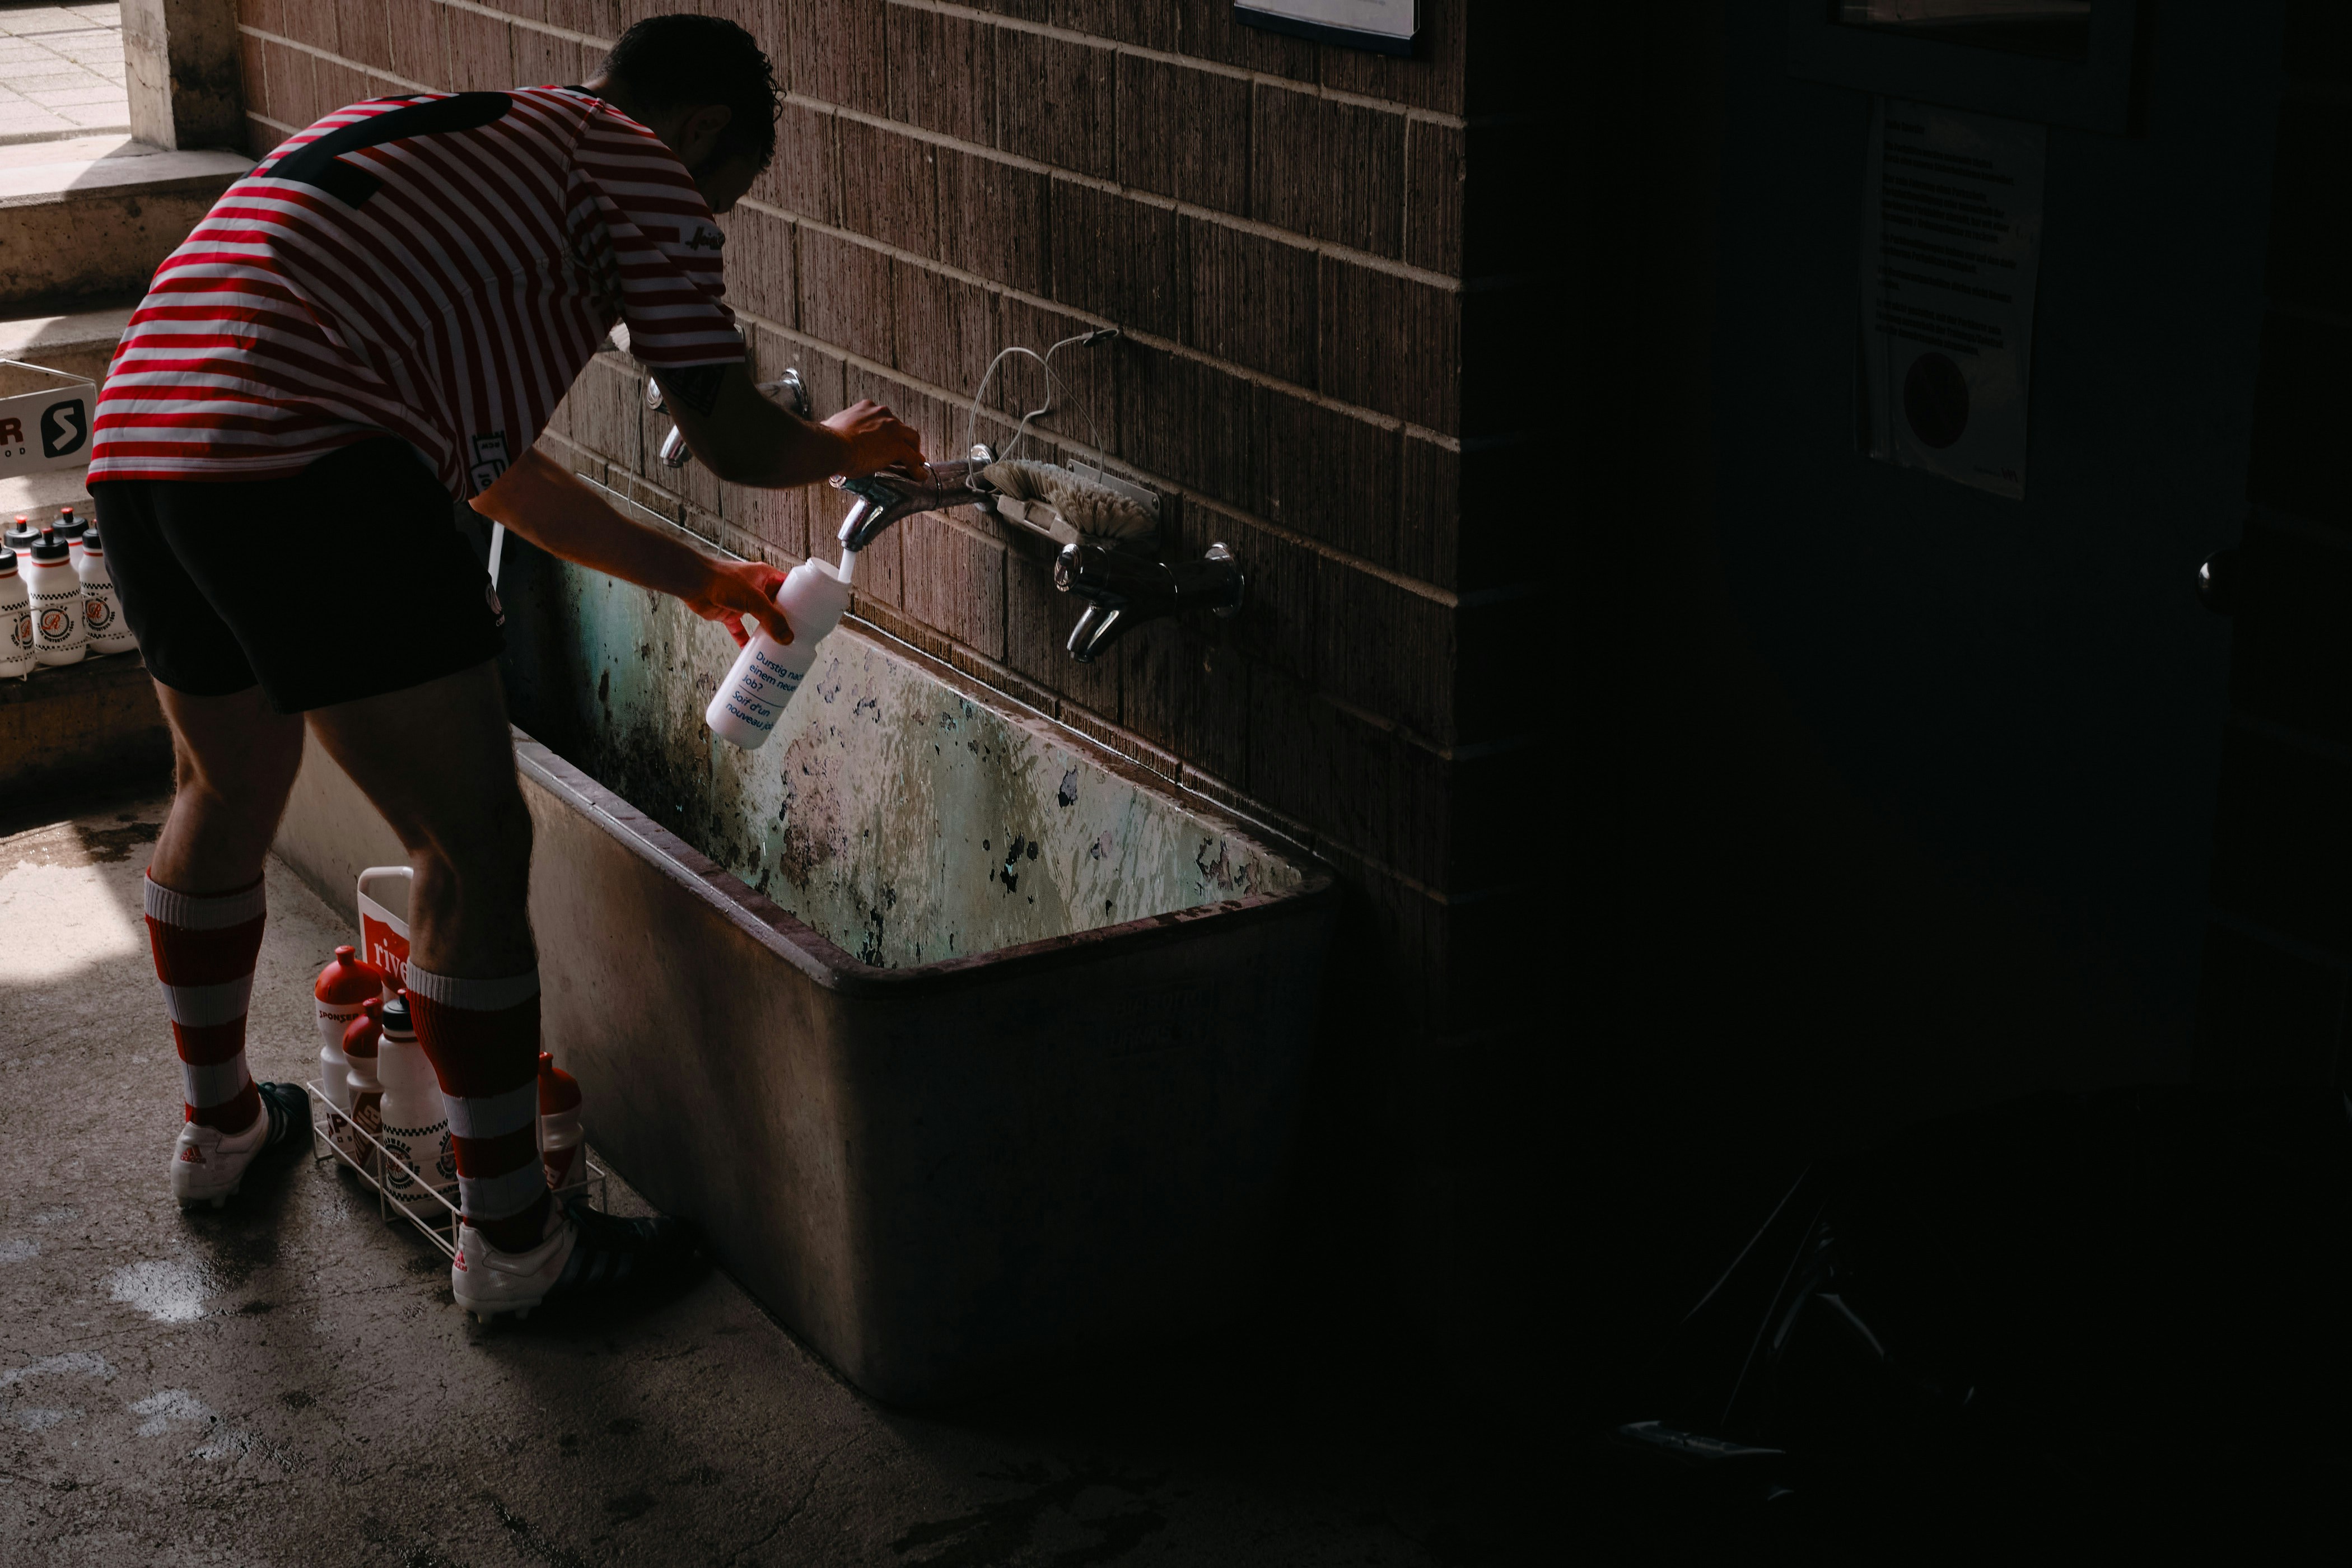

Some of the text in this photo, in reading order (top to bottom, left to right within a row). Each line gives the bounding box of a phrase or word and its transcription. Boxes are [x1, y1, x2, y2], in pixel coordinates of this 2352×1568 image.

[749, 665, 776, 685] einem
[756, 651, 787, 678] Durstig
[742, 674, 763, 692] Job?
[726, 703, 763, 728] nouveau
[732, 691, 771, 717] Soif d'un
